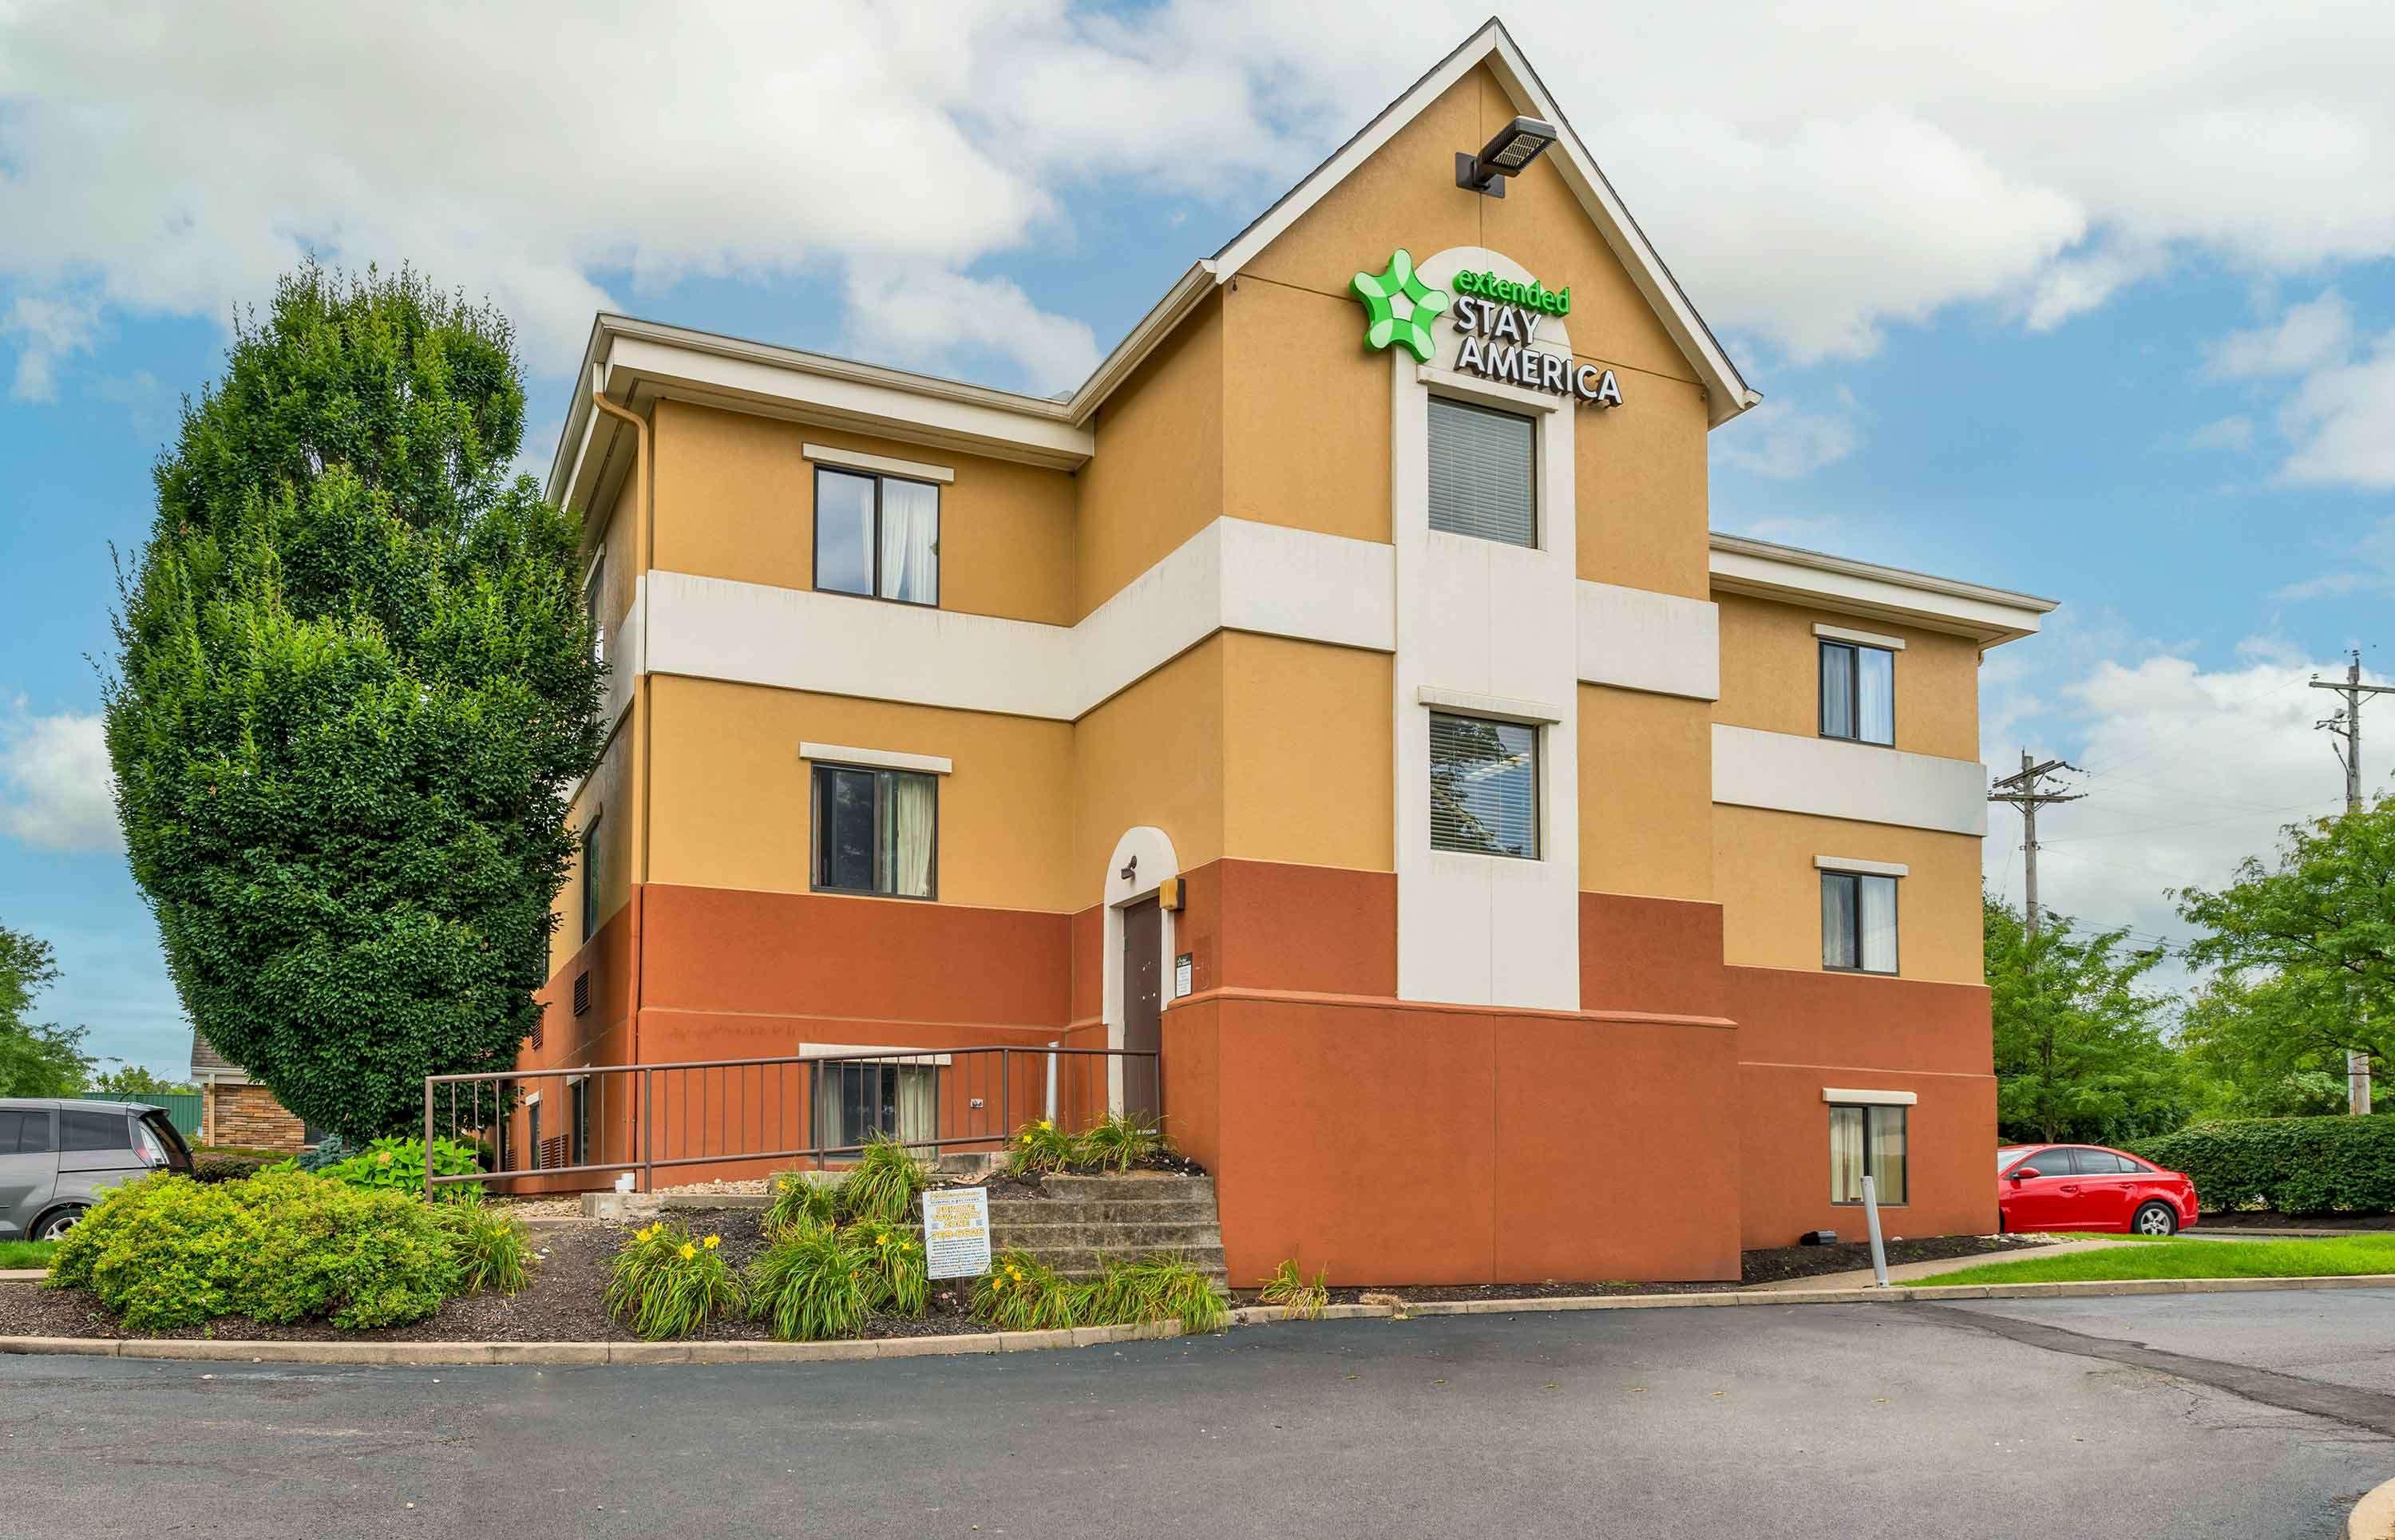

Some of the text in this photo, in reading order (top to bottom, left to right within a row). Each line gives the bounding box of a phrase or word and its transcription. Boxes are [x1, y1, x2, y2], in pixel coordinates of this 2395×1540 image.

[1455, 269, 1570, 316] extended
[1454, 295, 1542, 346] STAY
[1455, 335, 1623, 406] AMERICA
[944, 1219, 970, 1228] ZONE
